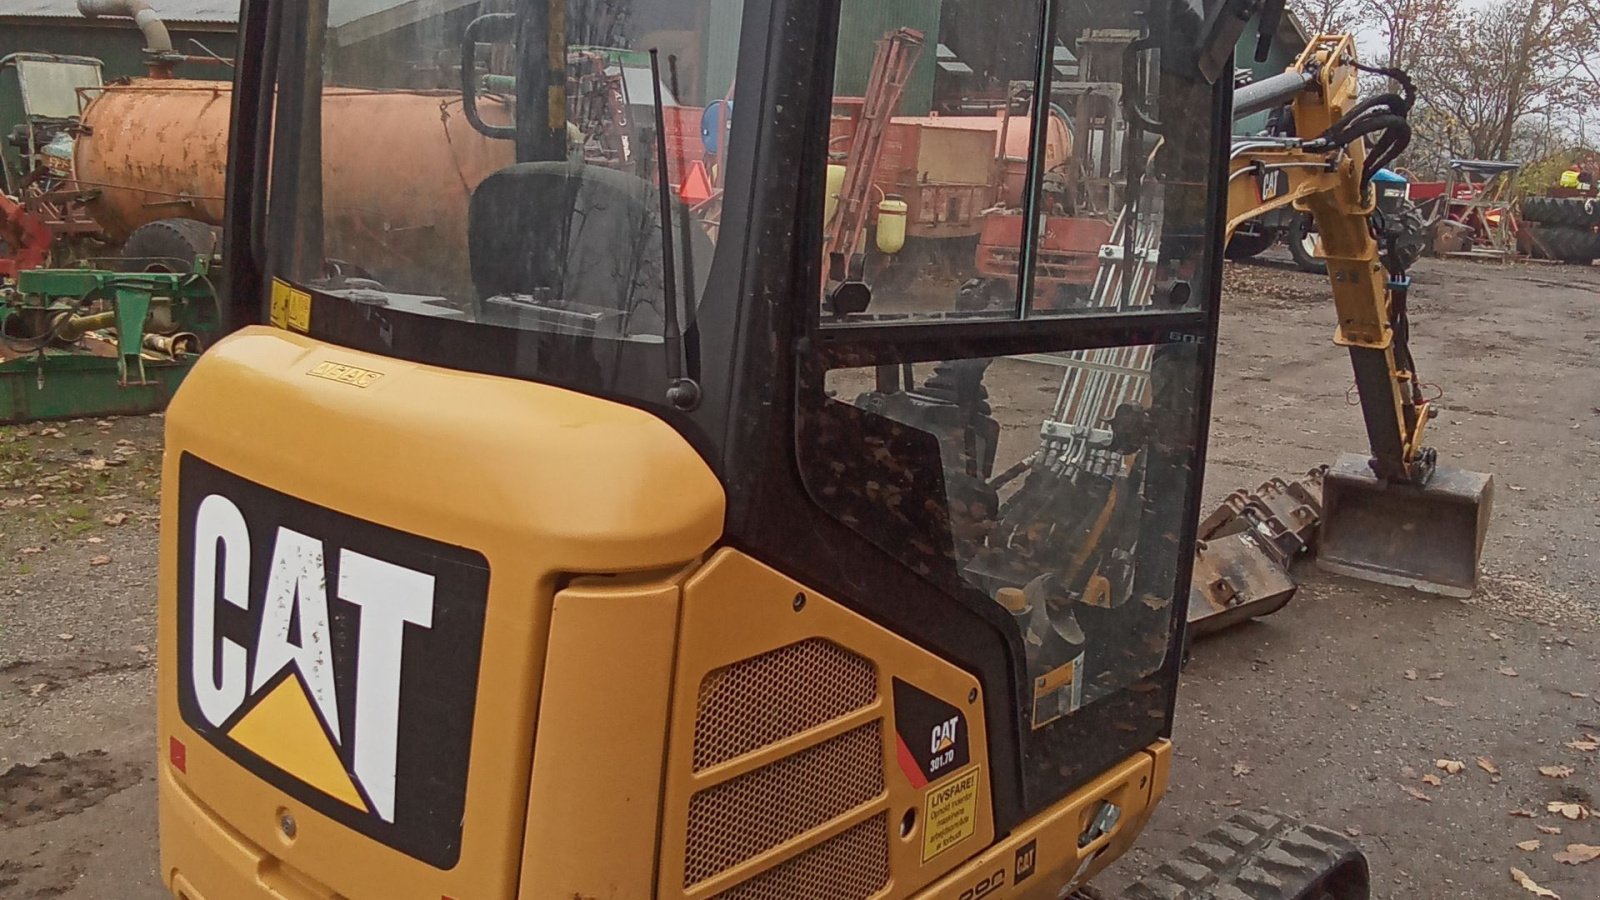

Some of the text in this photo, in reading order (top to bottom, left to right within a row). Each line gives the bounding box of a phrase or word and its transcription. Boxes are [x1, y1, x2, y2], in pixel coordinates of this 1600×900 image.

[1262, 170, 1280, 200] CAT
[192, 494, 436, 824] CAT
[930, 715, 959, 754] CAT
[1017, 848, 1034, 875] CAT
